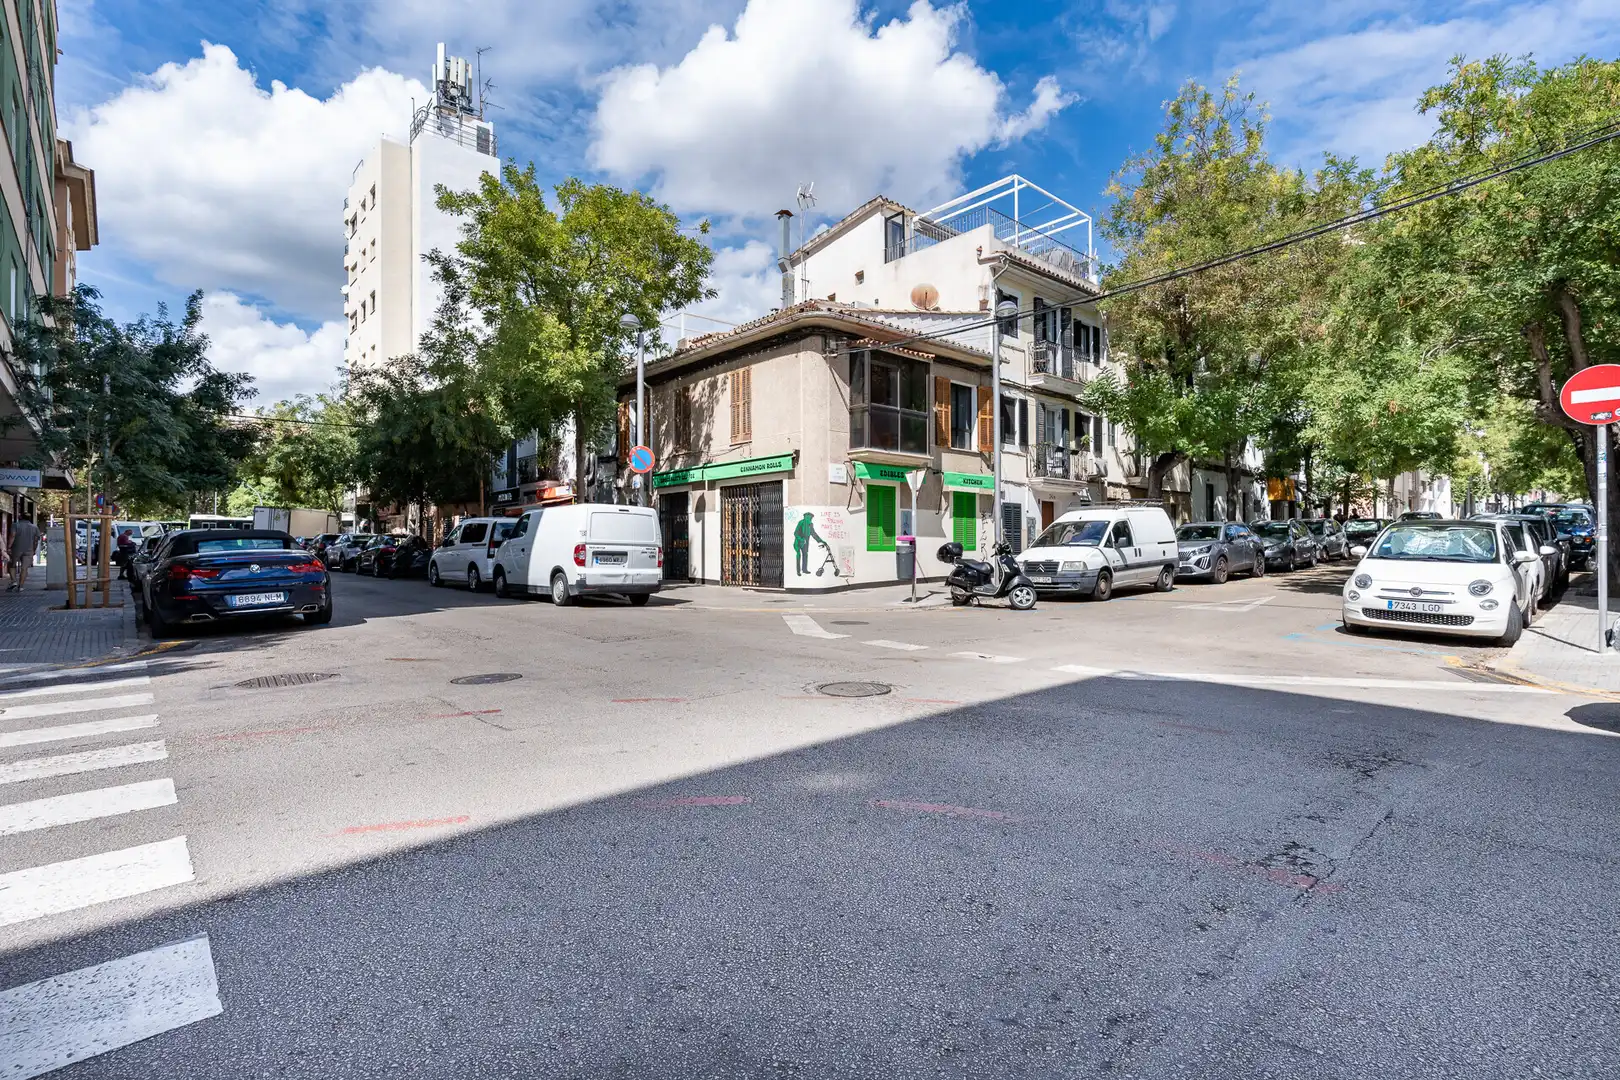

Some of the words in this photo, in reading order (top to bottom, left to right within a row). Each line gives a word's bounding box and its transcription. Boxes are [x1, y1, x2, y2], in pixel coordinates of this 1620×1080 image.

[740, 464, 766, 473] CINNAMON
[766, 461, 782, 470] ROLLS
[880, 469, 905, 479] EDIBLES
[962, 477, 983, 486] KITCHEN
[265, 593, 281, 601] NLM
[1394, 601, 1417, 610] 7343
[1422, 603, 1441, 612] LGD
